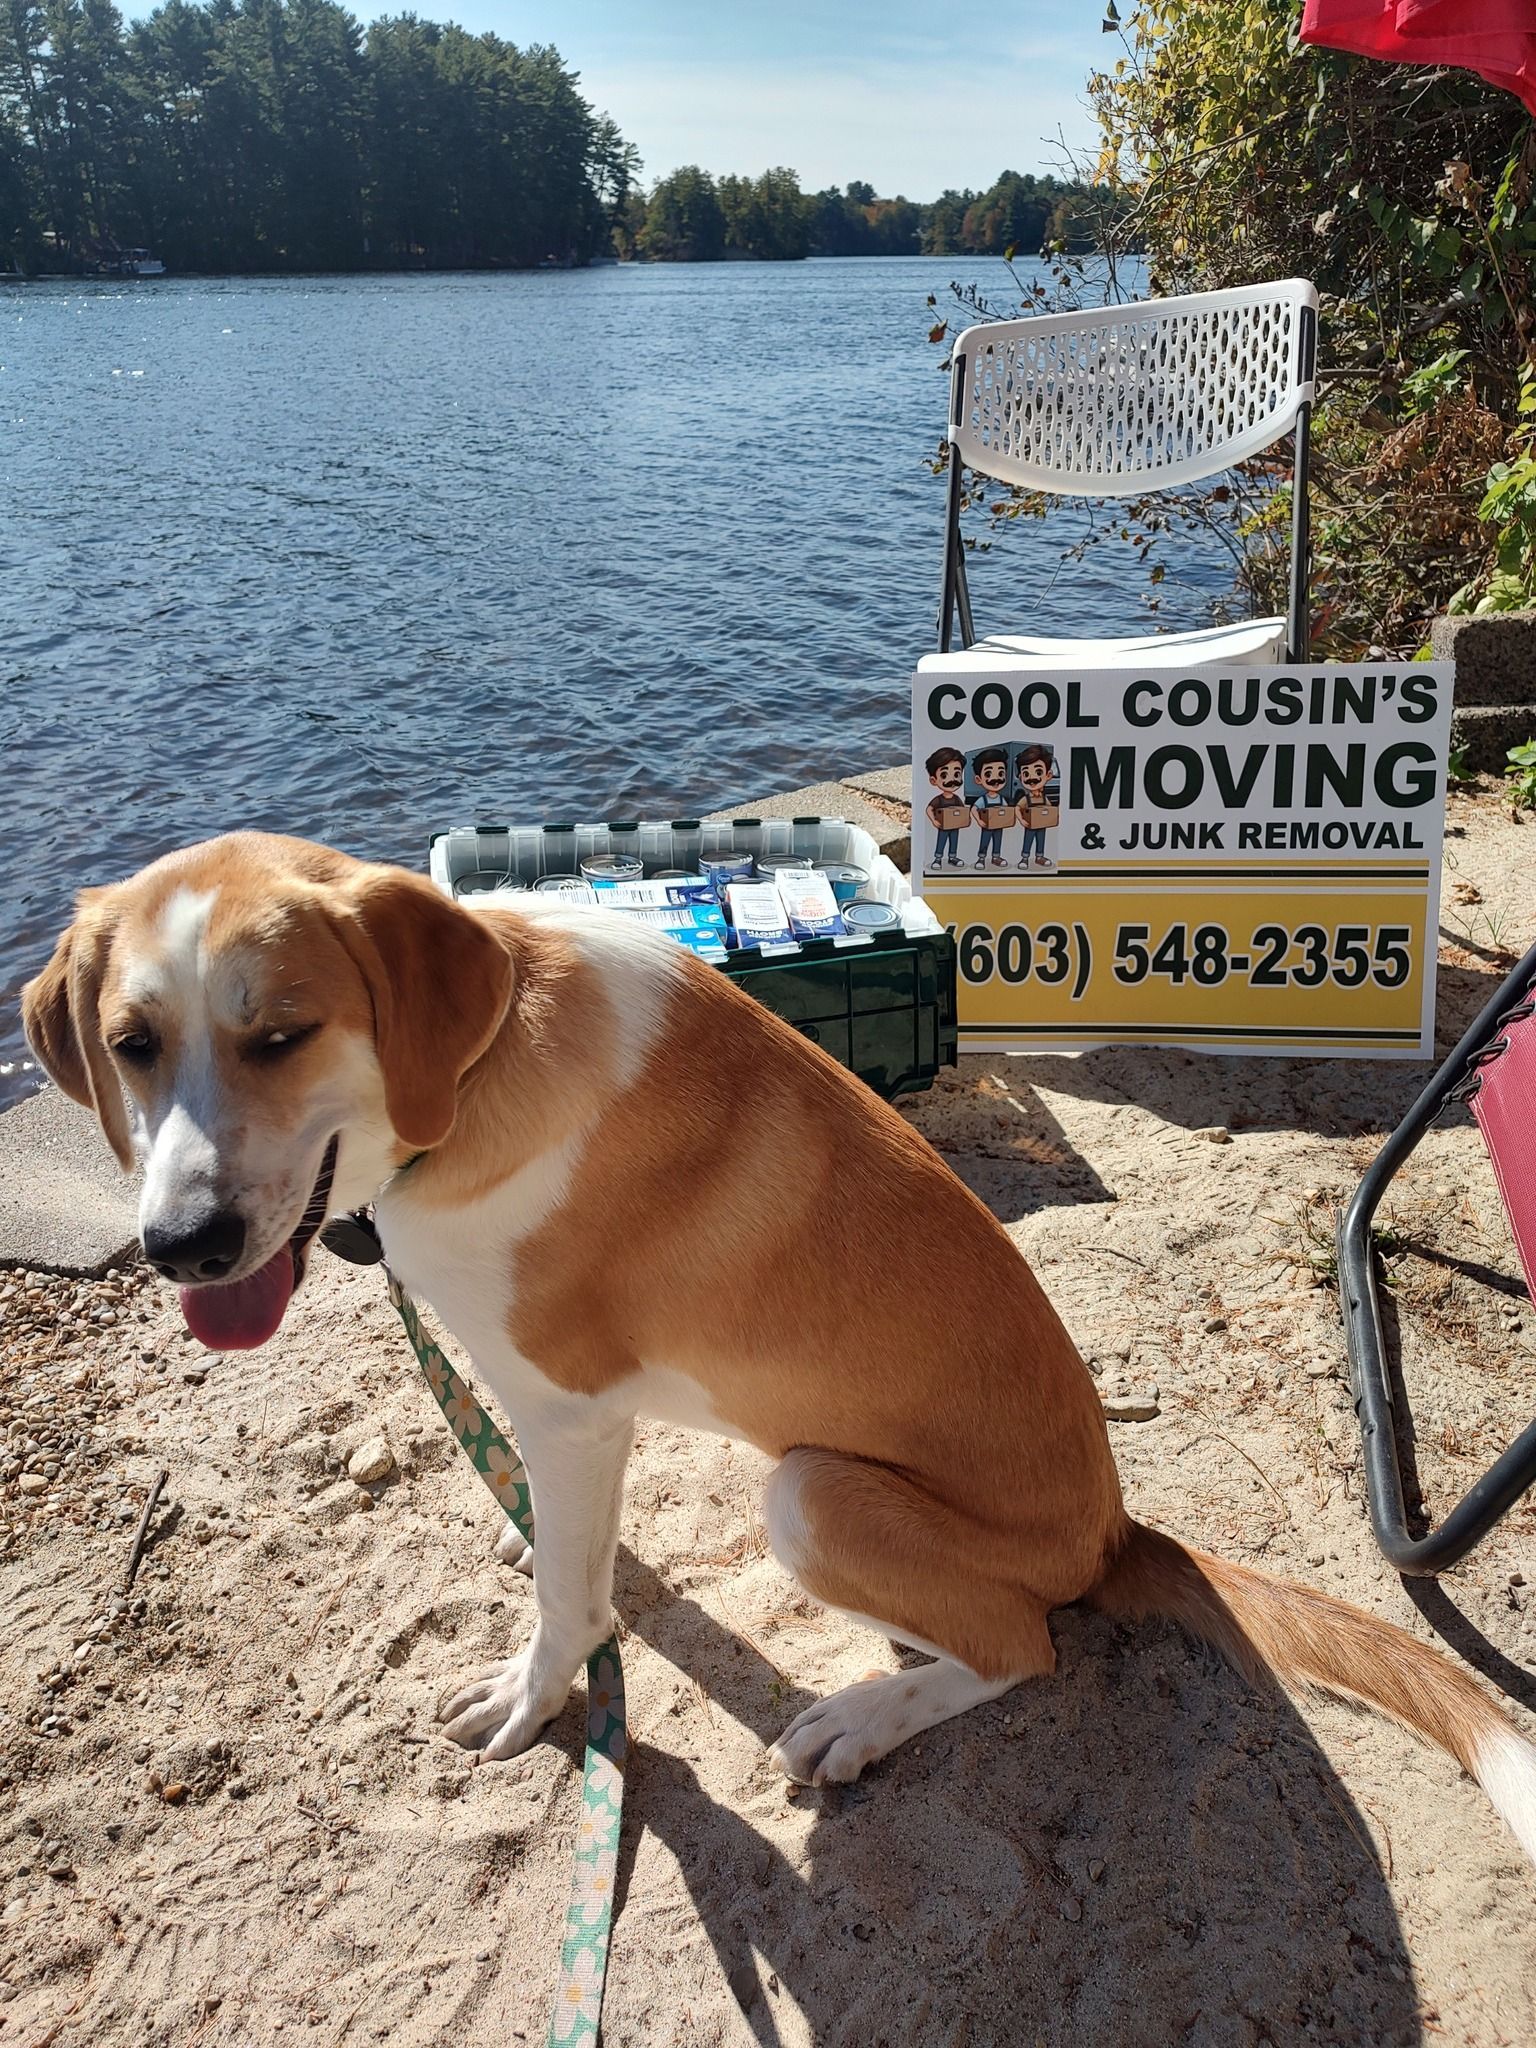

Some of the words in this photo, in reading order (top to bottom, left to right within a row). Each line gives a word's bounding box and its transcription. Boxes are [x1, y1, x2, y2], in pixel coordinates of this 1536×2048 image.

[927, 681, 1100, 731] COOL
[1122, 675, 1438, 728] COUSIN'S
[1068, 741, 1437, 810] MOVING
[1080, 822, 1107, 850] &
[1118, 821, 1226, 850] JUNK
[1238, 821, 1424, 850] REMOVAL
[945, 921, 1092, 1000] 603)
[1112, 924, 1411, 989] 548-2355
